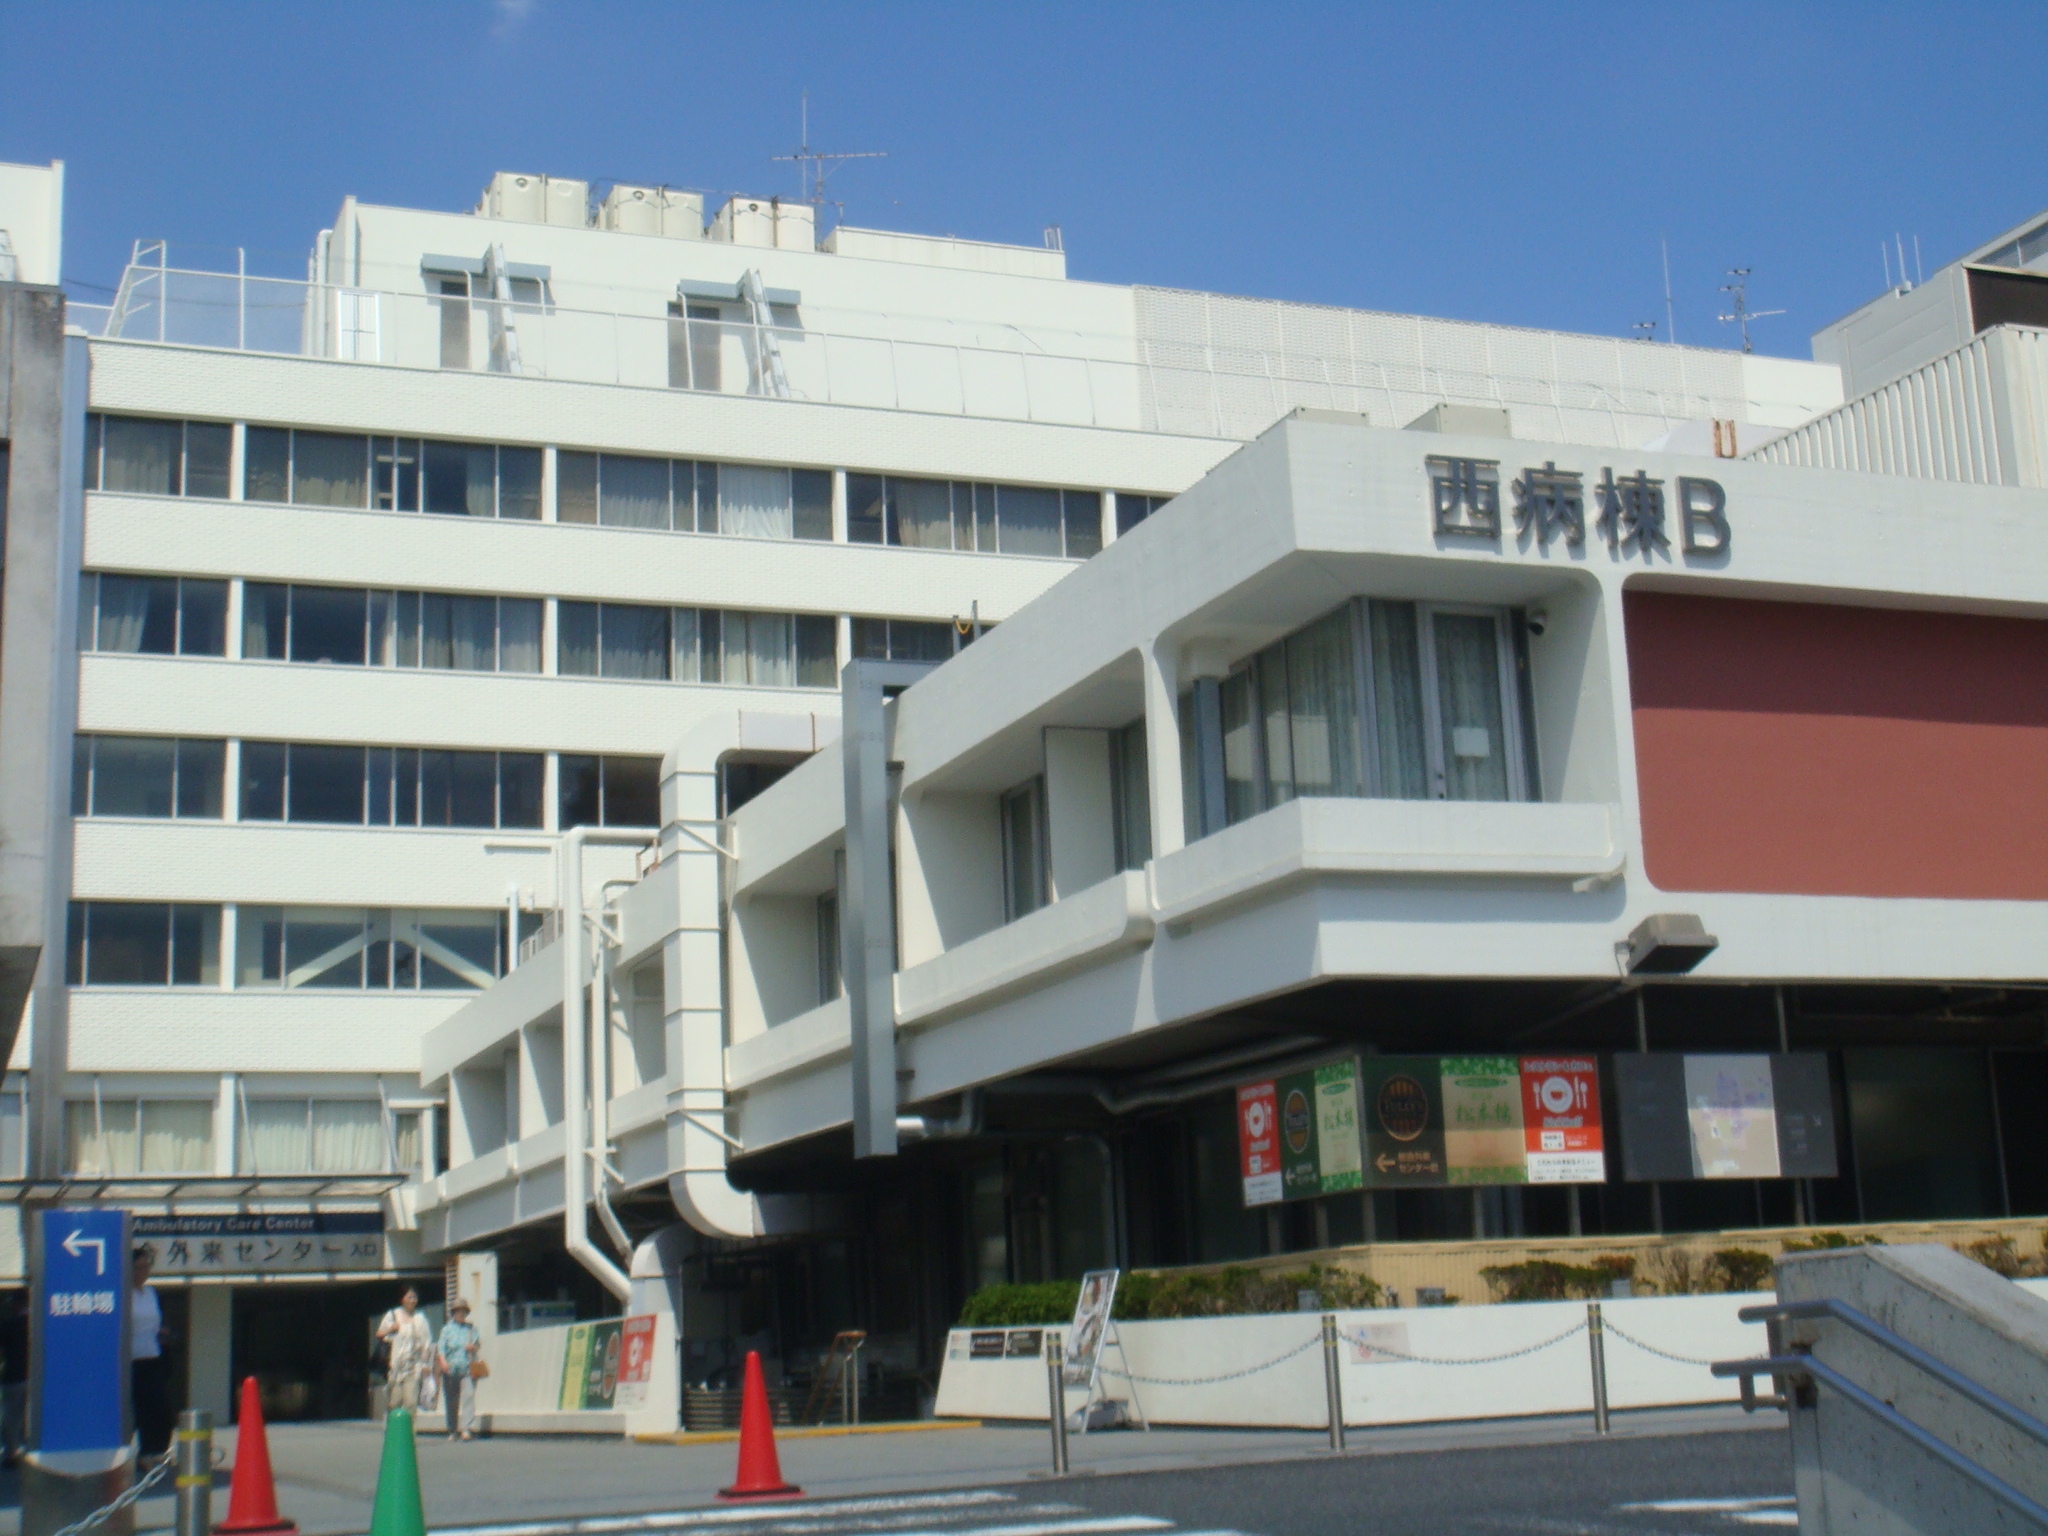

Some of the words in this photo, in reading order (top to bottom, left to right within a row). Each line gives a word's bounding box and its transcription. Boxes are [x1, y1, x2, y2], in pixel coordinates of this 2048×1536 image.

[1424, 454, 1732, 559] 西病棟B
[133, 1216, 222, 1233] Ambulatory
[225, 1215, 261, 1230] Care
[264, 1215, 316, 1230] Center
[50, 1291, 115, 1317] 駐輪場
